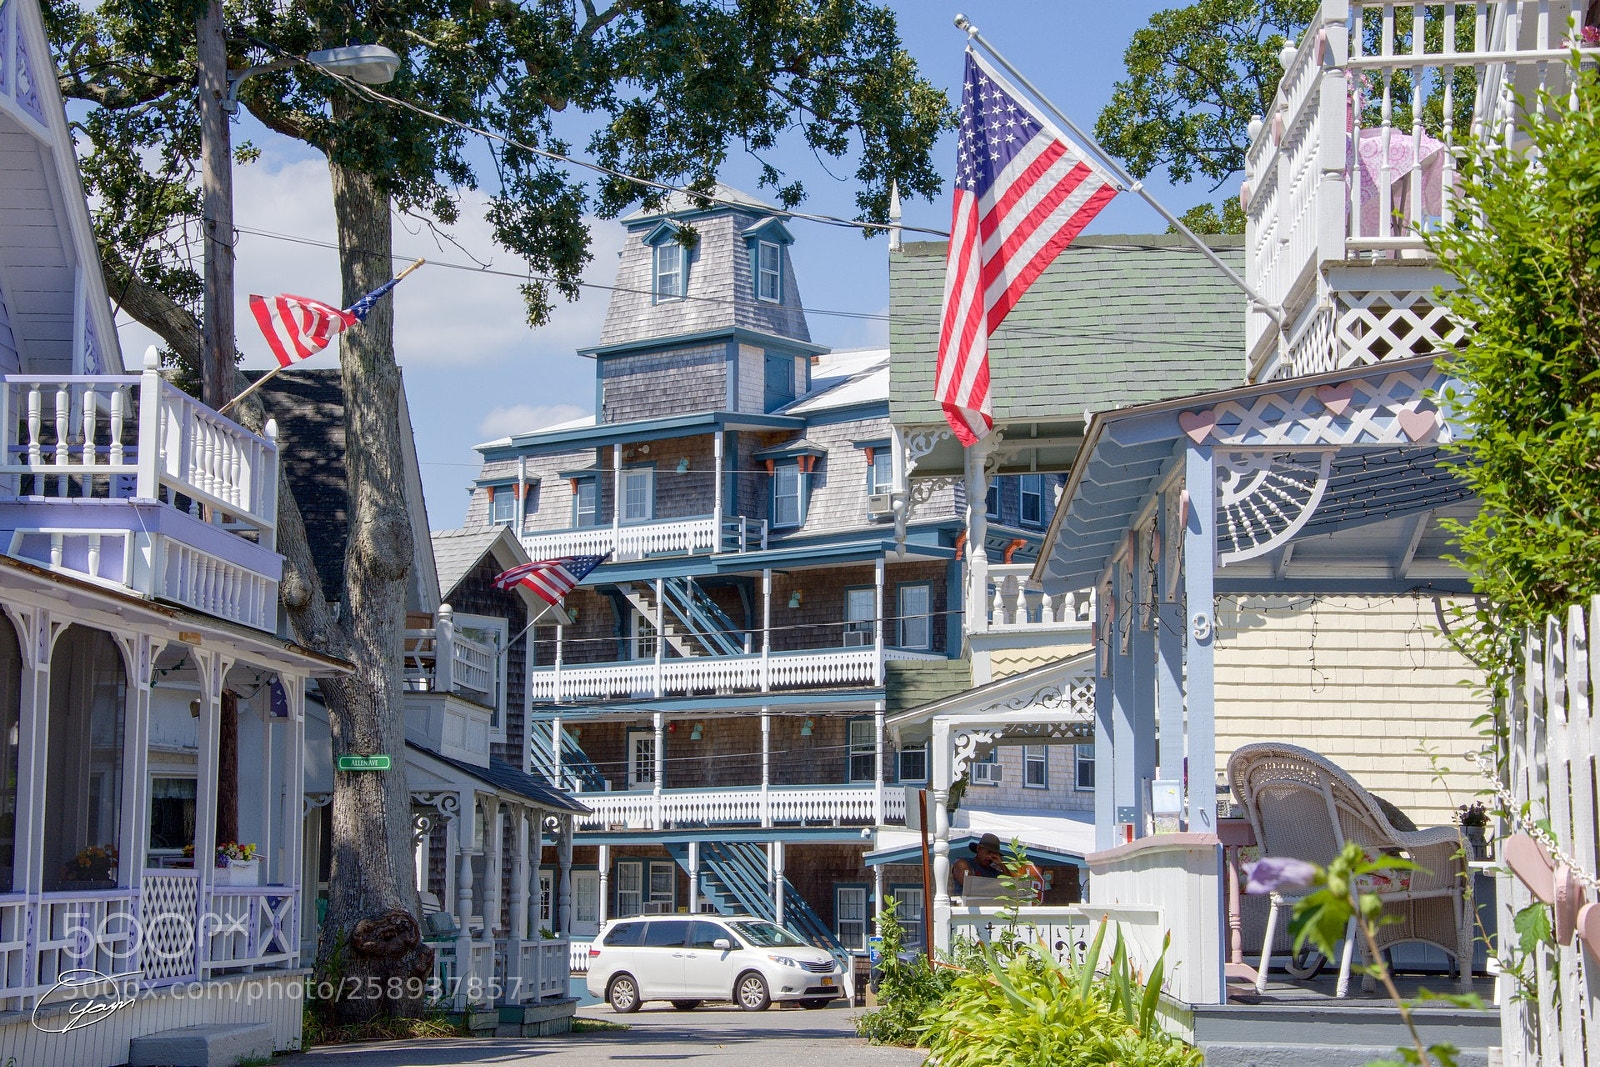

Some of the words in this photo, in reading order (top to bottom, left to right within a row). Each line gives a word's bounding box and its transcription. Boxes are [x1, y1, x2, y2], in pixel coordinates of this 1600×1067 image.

[1192, 612, 1211, 640] 9
[350, 759, 368, 767] ALLEN
[368, 759, 379, 767] AVE
